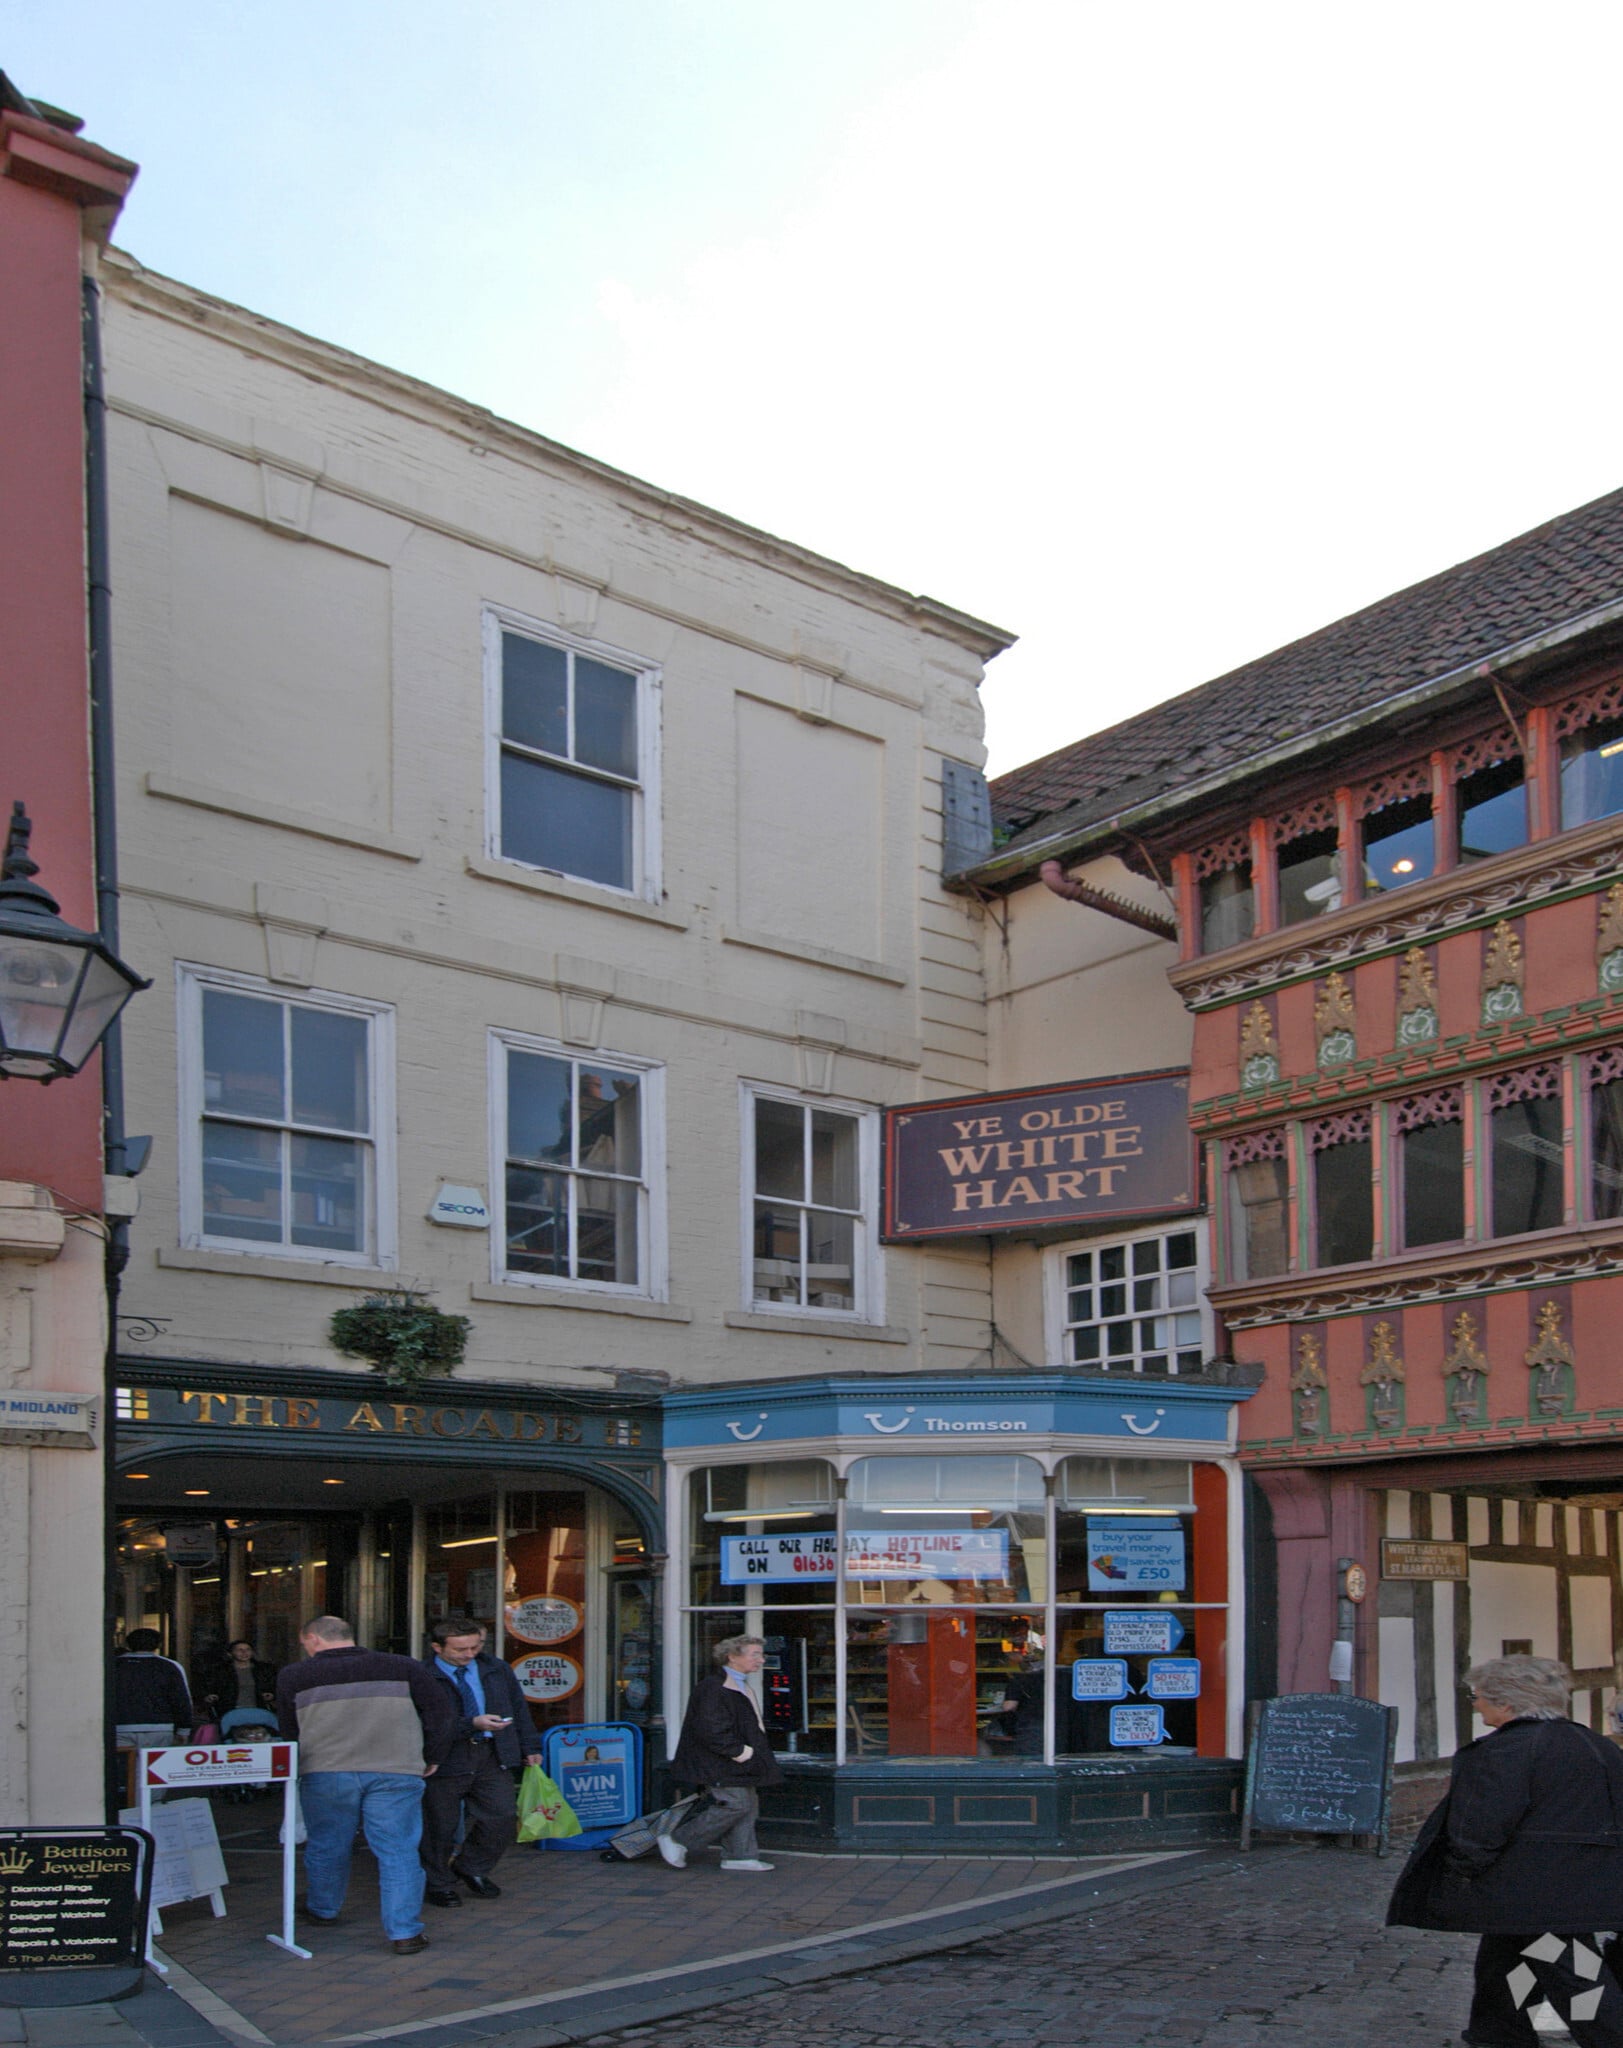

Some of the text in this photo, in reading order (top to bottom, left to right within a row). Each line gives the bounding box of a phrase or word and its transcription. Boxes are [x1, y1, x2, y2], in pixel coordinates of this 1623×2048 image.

[953, 1100, 1127, 1140] YE OLDE
[938, 1125, 1144, 1176] WHITE
[952, 1165, 1127, 1211] HART
[10, 1401, 79, 1415] MIDLAND
[182, 1390, 584, 1444] THE ARCADE
[924, 1418, 1028, 1432] Thomson
[1102, 1533, 1153, 1543] buy your
[739, 1536, 962, 1555] CALL OUR HOLAY HOTLINE
[1092, 1543, 1172, 1554] travel money
[1388, 1544, 1416, 1555] WHITE
[747, 1557, 768, 1573] ON
[793, 1554, 835, 1572] 01636
[1435, 1564, 1461, 1575] PLACE
[1138, 1567, 1169, 1579] £50
[524, 1659, 567, 1669] SPECIAL
[529, 1669, 562, 1678] DEALS
[571, 1774, 616, 1792] WIN
[1281, 1803, 1296, 1821] 2
[43, 1845, 128, 1859] Bettison
[40, 1860, 132, 1874] Jewellers
[11, 1885, 93, 1893] Diamond Rings
[61, 1898, 111, 1906] Jewellery
[9, 1911, 106, 1921] Designer Watches
[7, 1940, 48, 1948] Repairs
[62, 1937, 118, 1945] Valuations
[8, 1953, 96, 1963] 5 The Arcade
